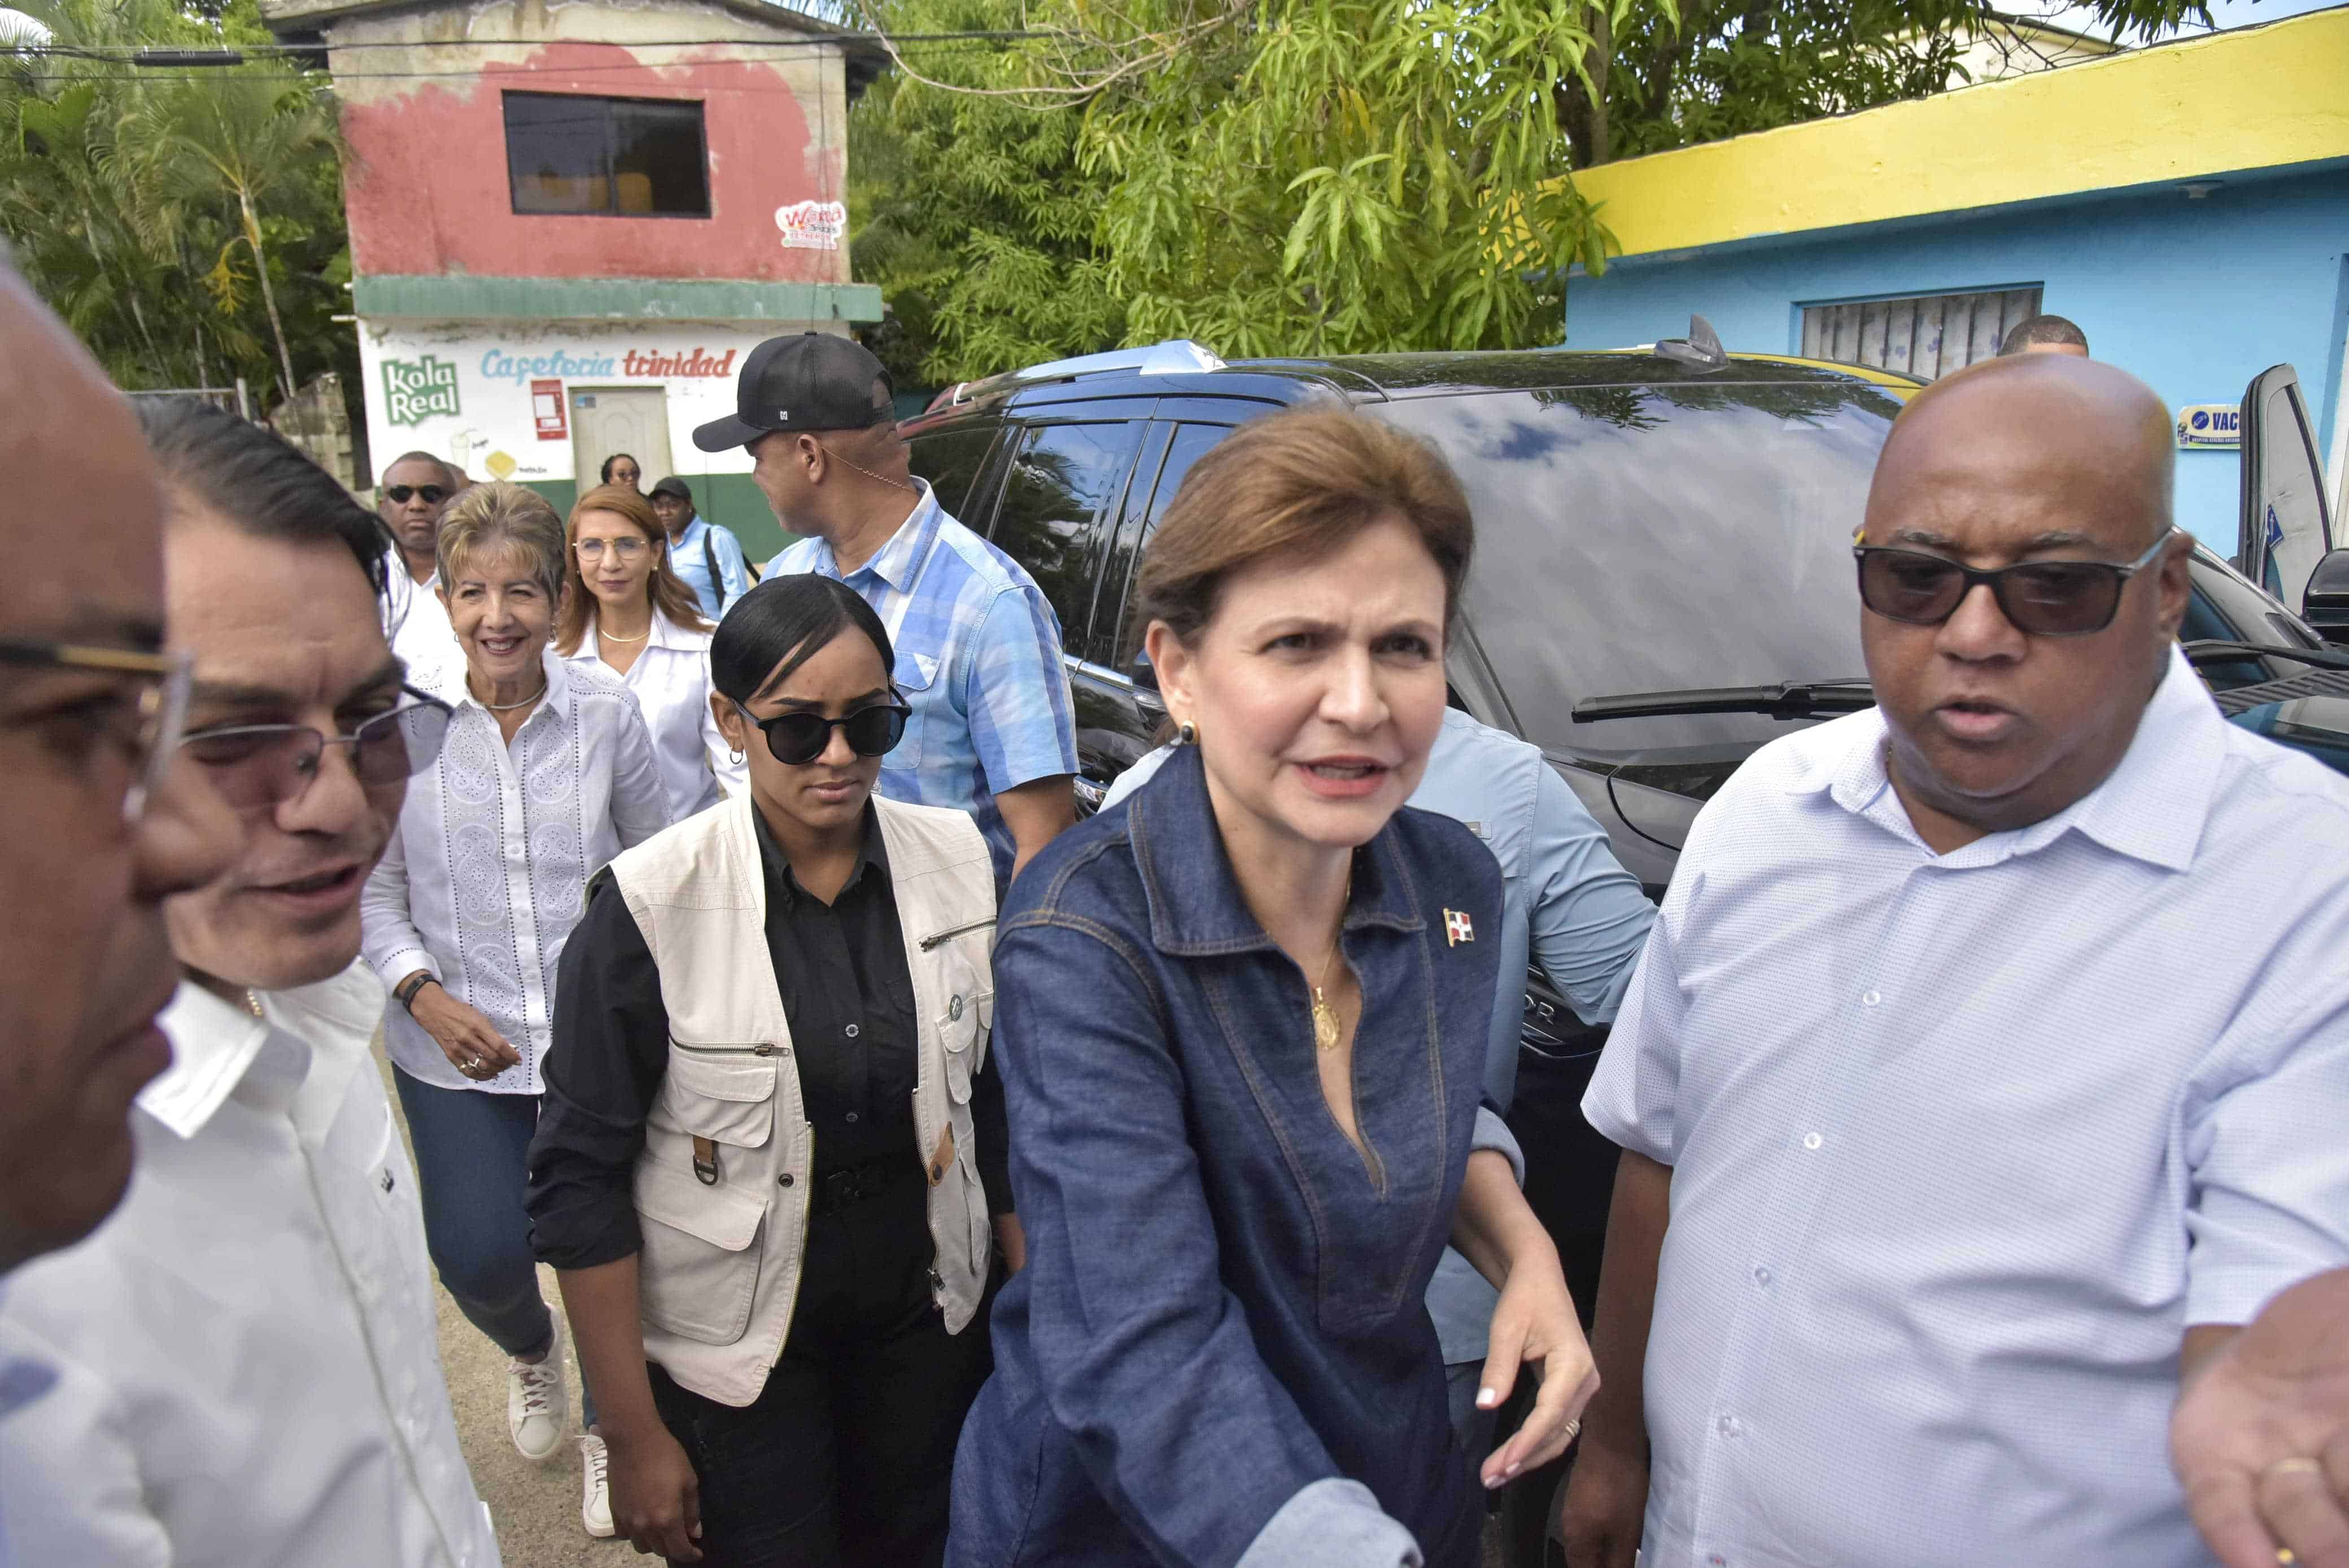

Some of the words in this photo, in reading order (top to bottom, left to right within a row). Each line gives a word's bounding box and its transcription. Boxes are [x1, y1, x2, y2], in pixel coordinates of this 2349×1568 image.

[387, 359, 454, 395] Kola
[623, 347, 737, 378] trinidad
[391, 386, 457, 421] Real
[2212, 412, 2241, 431] VAC
